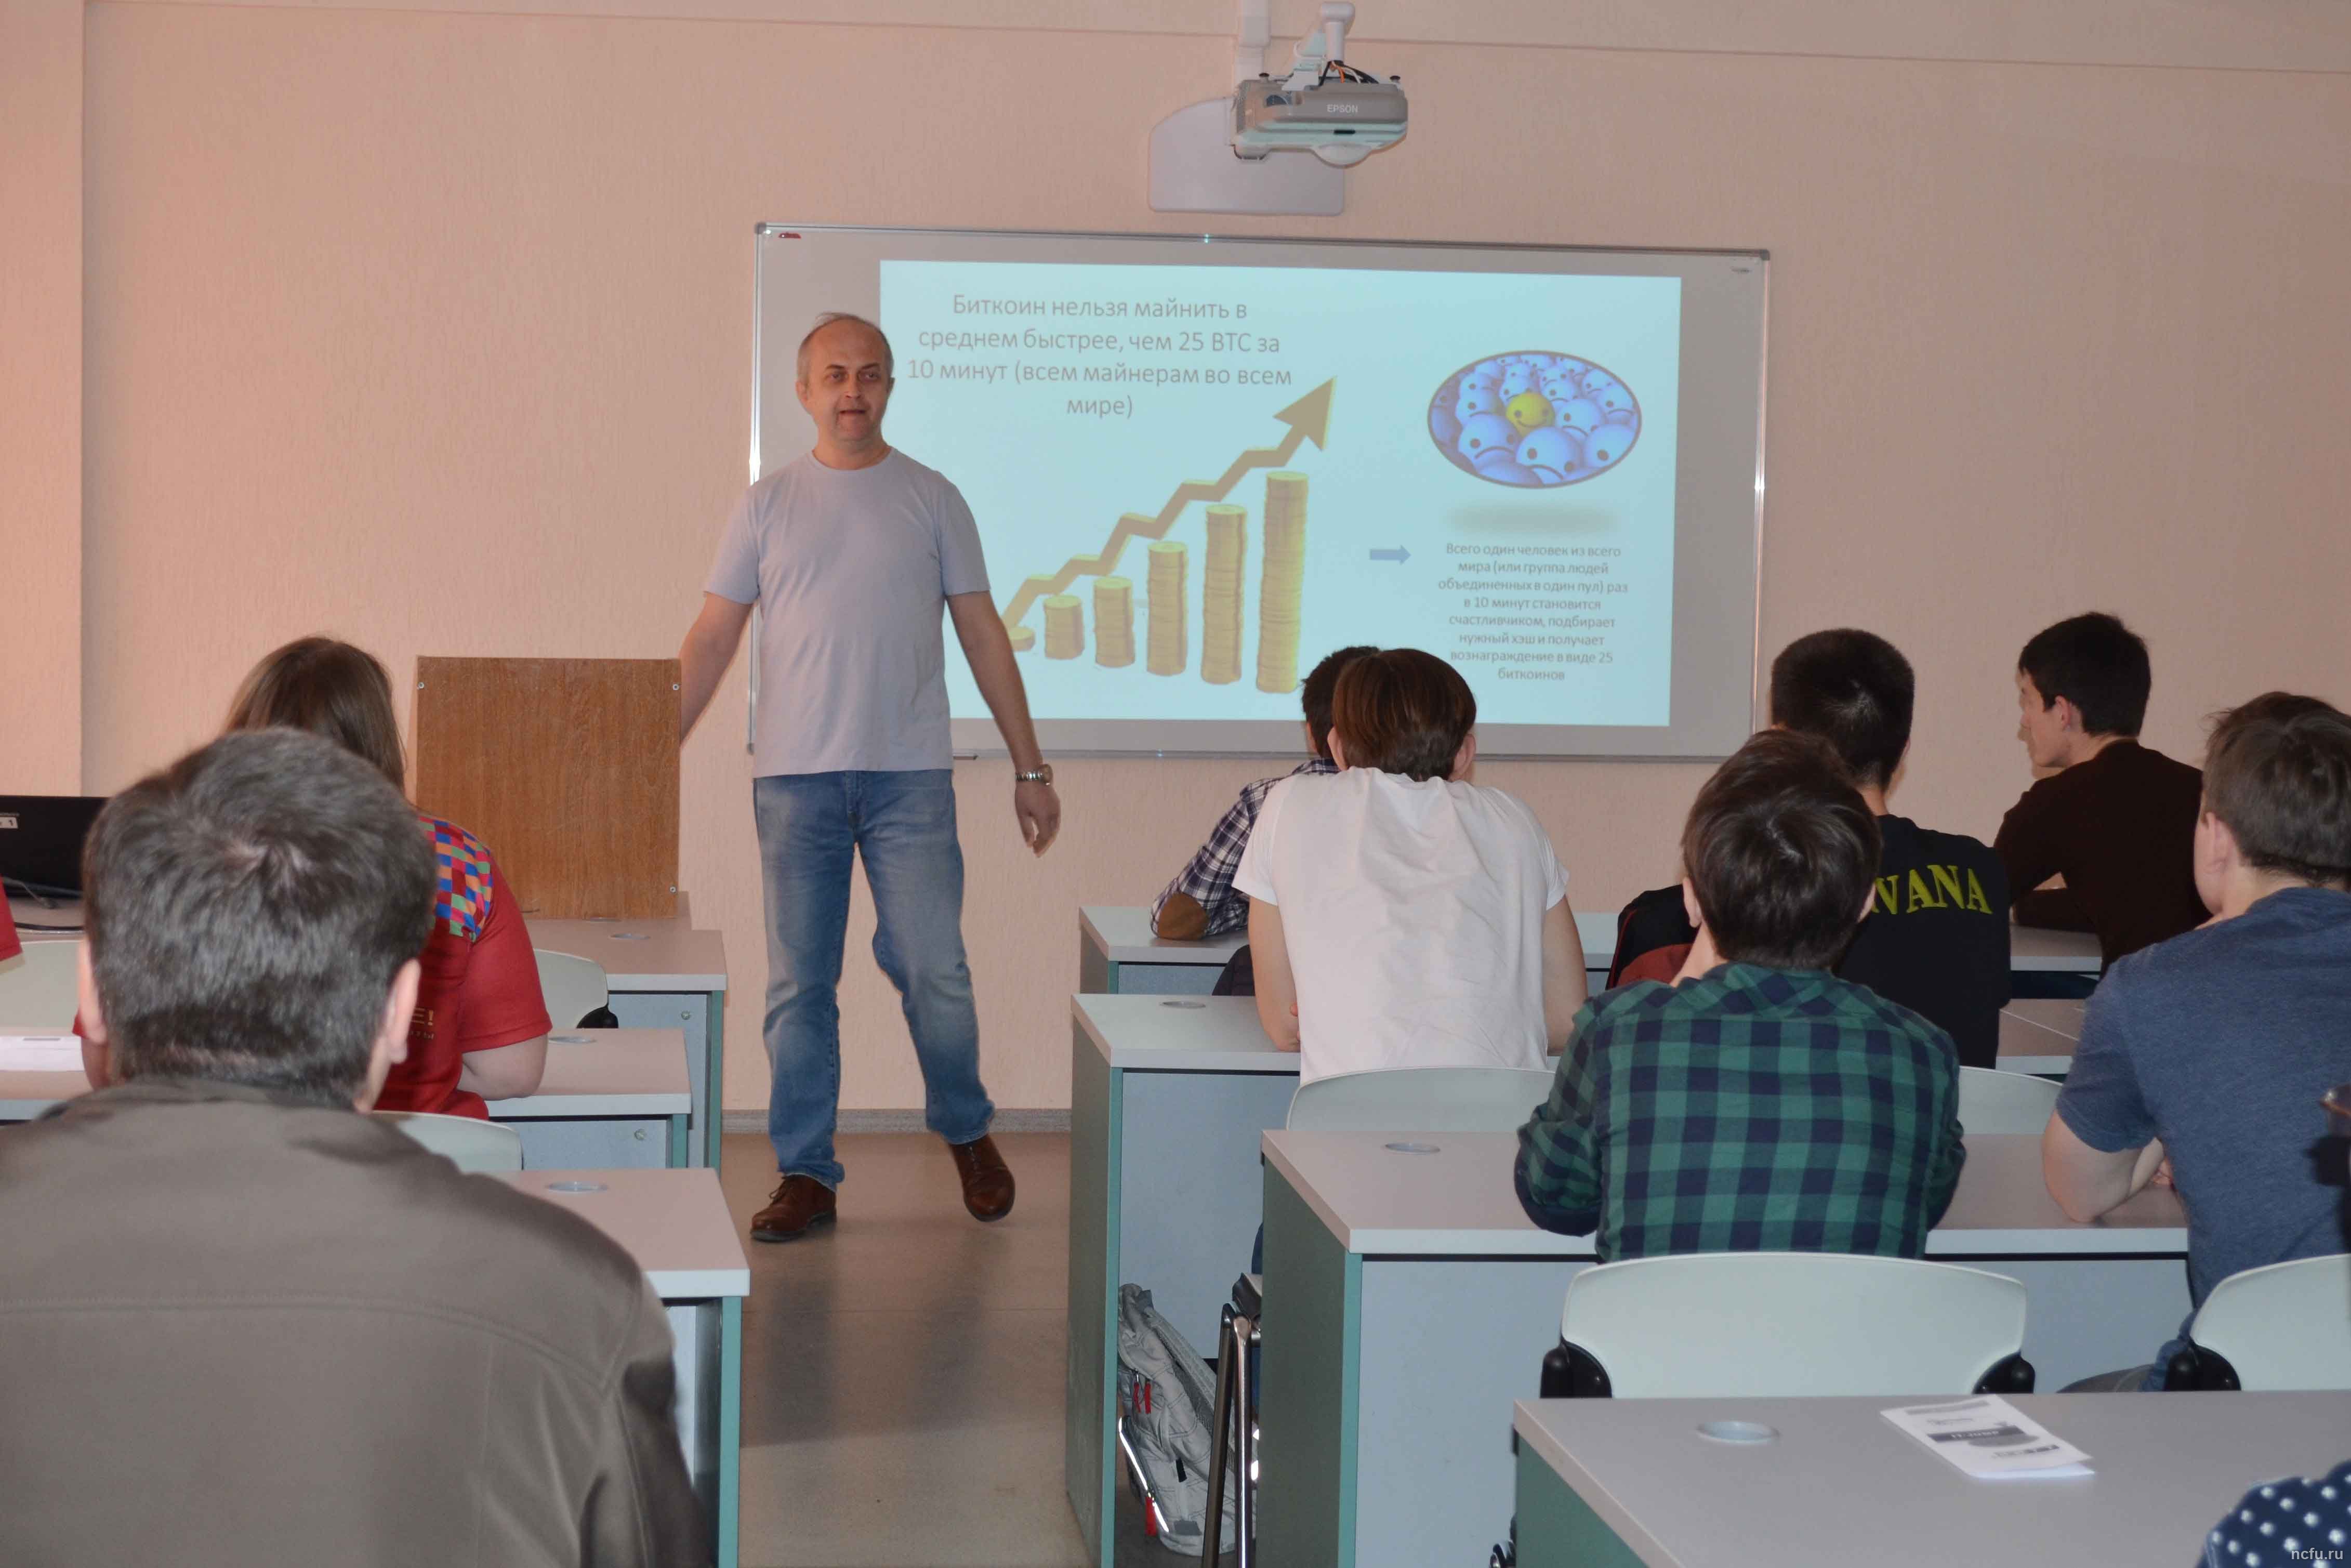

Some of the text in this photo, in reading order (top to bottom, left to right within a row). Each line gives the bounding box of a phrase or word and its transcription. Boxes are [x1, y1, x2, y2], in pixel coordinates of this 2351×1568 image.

[1327, 104, 1358, 113] EPSON
[953, 295, 1247, 319] Биткоин нельзя майнить в
[919, 331, 1018, 351] среднем
[1024, 329, 1123, 353] быстрее,
[1129, 335, 1171, 351] чем
[1179, 333, 1204, 351] 25
[1258, 337, 1279, 353] за
[907, 360, 1291, 387] 10 минут (всем майнерам во всем
[1067, 394, 1132, 419] мире)
[1447, 543, 1621, 557] Всего один человек из всего
[1459, 561, 1609, 576] мира (или группа людей
[1534, 582, 1540, 590] в
[1543, 582, 1575, 593] один
[1578, 581, 1604, 594] пул)
[1607, 583, 1628, 595] раз
[1464, 597, 1601, 611] в 10 минут становится
[1449, 615, 1615, 629] счастливчиком, подбирает
[1459, 631, 1605, 647] нужный хэш и получает
[1450, 651, 1613, 664] вознаграждение в виде 25
[1498, 667, 1565, 680] биткоинов
